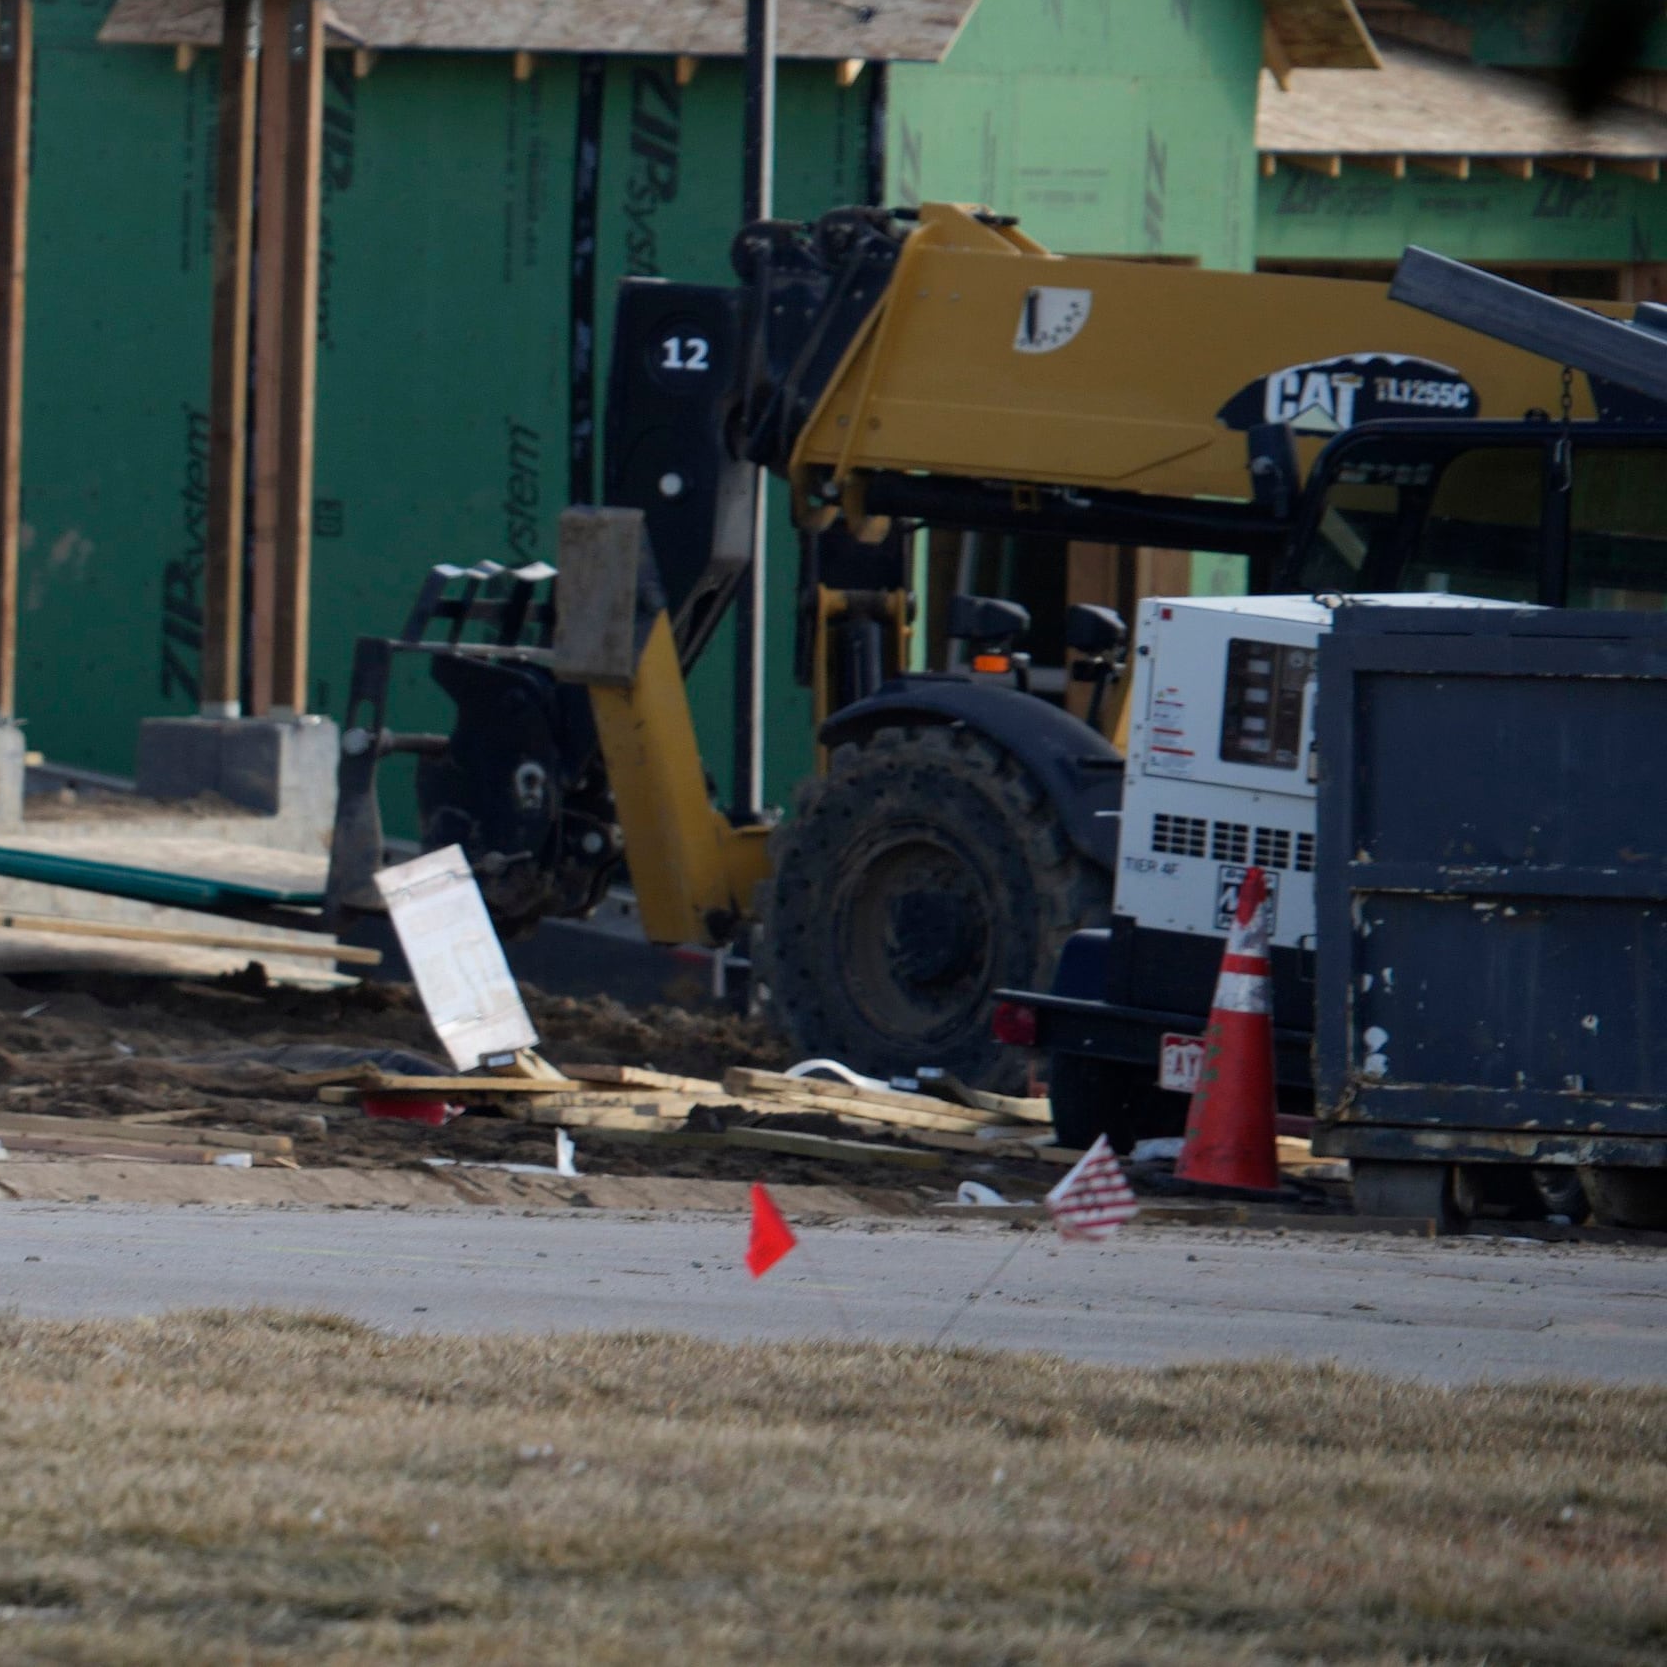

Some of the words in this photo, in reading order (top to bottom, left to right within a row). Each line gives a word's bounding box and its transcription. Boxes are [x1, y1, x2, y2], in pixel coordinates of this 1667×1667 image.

[660, 336, 709, 371] 12
[1263, 371, 1365, 431] CAT
[1373, 376, 1470, 409] TL1255C
